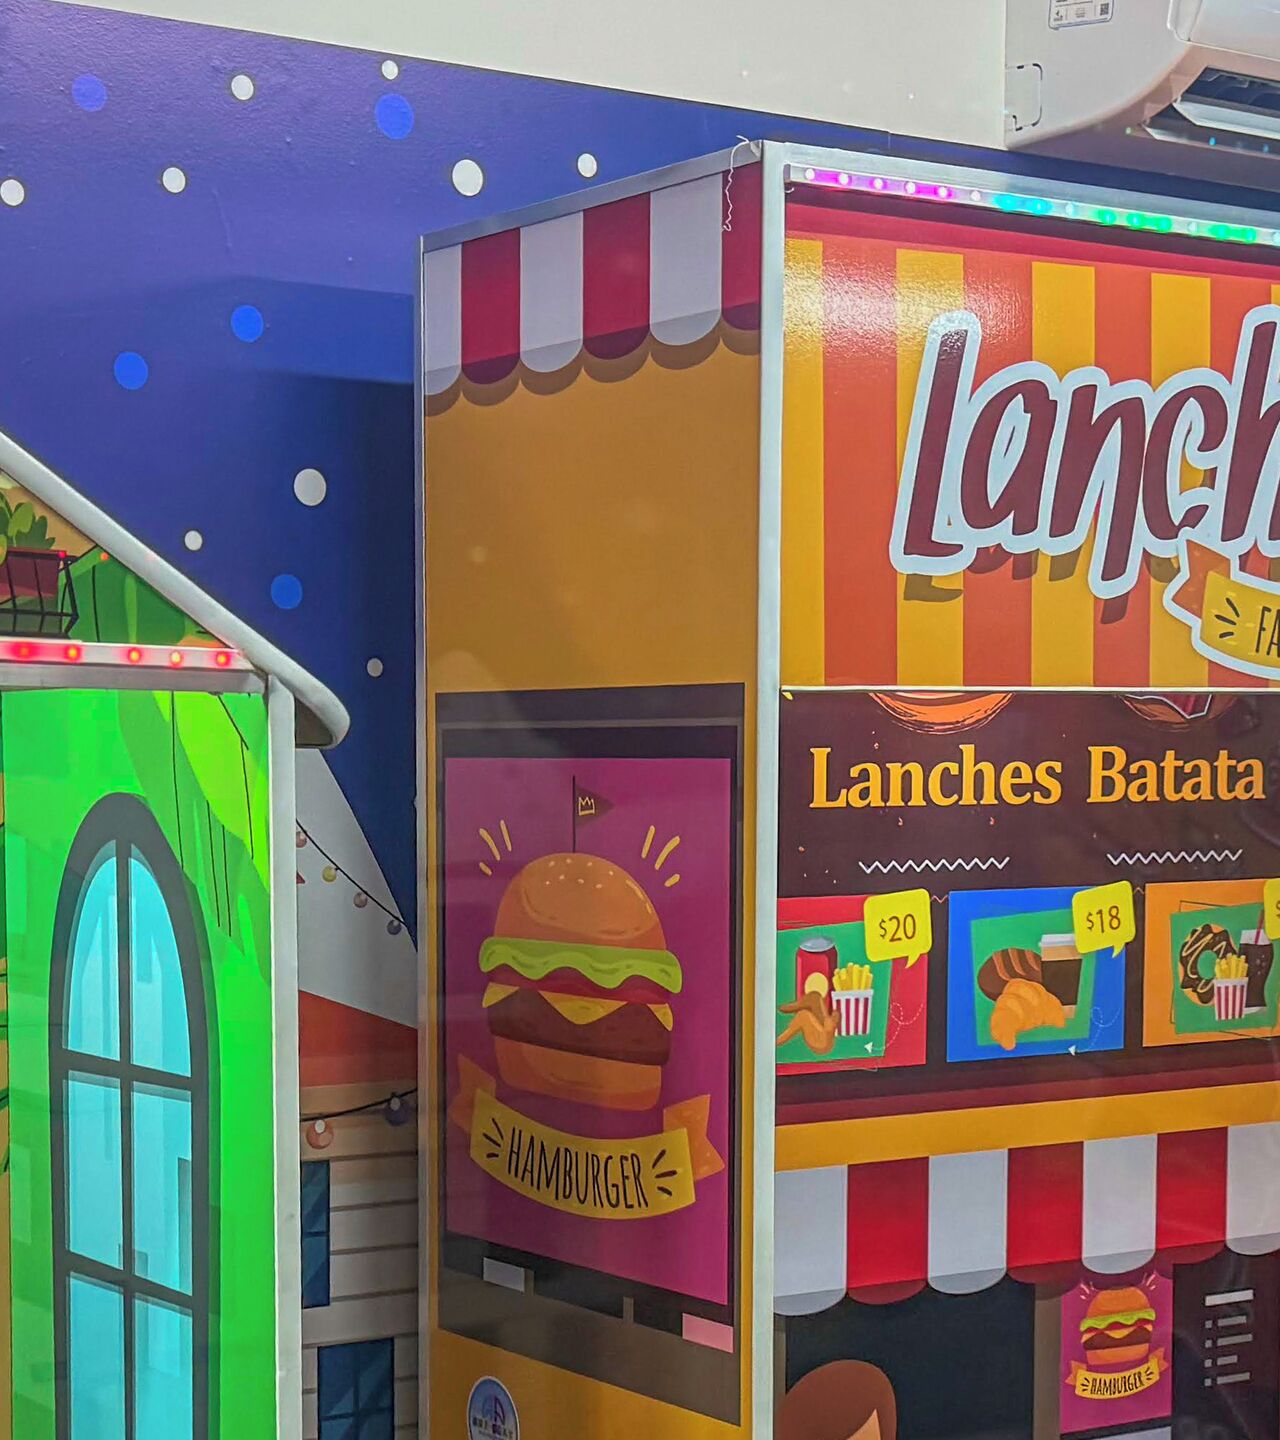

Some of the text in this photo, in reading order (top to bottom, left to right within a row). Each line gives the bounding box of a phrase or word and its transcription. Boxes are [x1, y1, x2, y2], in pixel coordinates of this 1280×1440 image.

[809, 743, 1062, 809] Lanches
[1086, 745, 1267, 805] Batata
[877, 911, 918, 943] $20
[1086, 905, 1121, 935] $18
[507, 1126, 649, 1209] HAMBURGER
